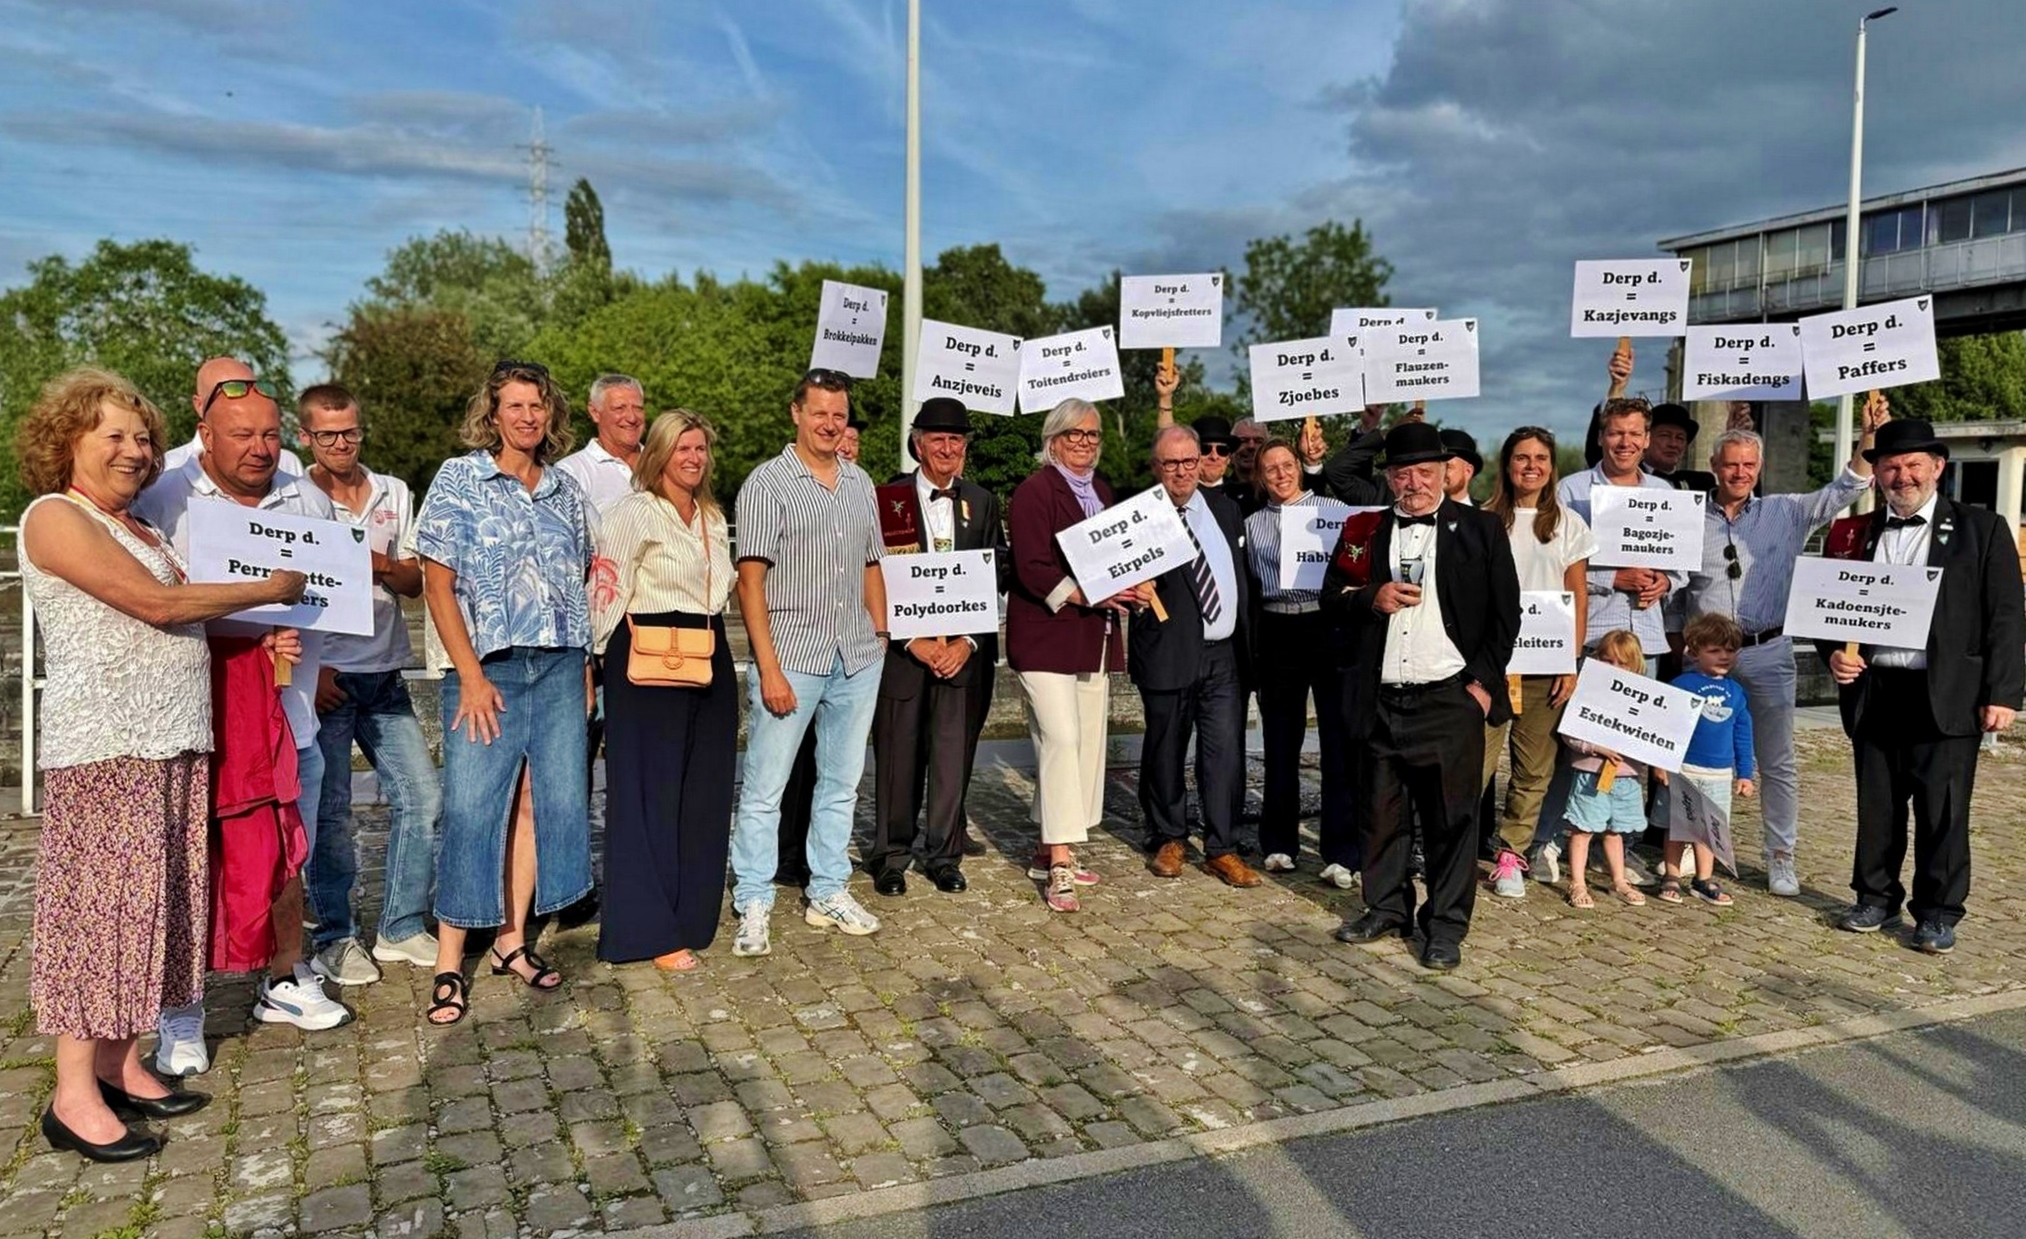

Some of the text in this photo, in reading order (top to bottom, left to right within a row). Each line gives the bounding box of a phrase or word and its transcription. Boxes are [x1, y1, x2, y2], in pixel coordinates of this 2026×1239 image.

[1603, 272, 1662, 286] Derp d.
[1155, 284, 1189, 294] Derp d.
[843, 298, 868, 313] Derp d.
[1132, 308, 1211, 319] Kopvliejsfretters
[1584, 309, 1676, 324] Kazjevangs
[1832, 315, 1902, 338] Derp d.
[824, 328, 877, 346] Brokkelpakken
[1399, 332, 1443, 344] Derp d.
[1715, 336, 1774, 351] Derp d.
[946, 337, 998, 358] Derp d.
[1042, 342, 1086, 358] Derp d.
[1278, 349, 1334, 366] Derp d.
[1396, 362, 1448, 372] Flauzen-
[1838, 360, 1906, 380] Paffers
[1028, 368, 1110, 389] Toitendroiers
[1396, 376, 1449, 386] maukers
[1698, 373, 1790, 388] Fiskadengs
[932, 375, 1001, 398] Anzjeveis
[1279, 388, 1339, 406] Zjoebes
[1628, 499, 1672, 512] Derp d.
[250, 522, 319, 544] Derp d.
[1088, 510, 1147, 544] Derp d.
[1623, 528, 1674, 542] Bagozje-
[1622, 544, 1673, 554] maukers
[1108, 548, 1164, 579] Eirpels
[1296, 551, 1332, 563] Habb
[911, 564, 966, 579] Derp d.
[1839, 572, 1894, 585] Derp d.
[894, 600, 986, 618] Polydoorkes
[1528, 604, 1541, 614] d.
[1816, 598, 1906, 616] Kadoensjte-
[1825, 617, 1890, 629] maukers
[1512, 637, 1564, 648] eleiters
[1610, 680, 1666, 709] Derp d.
[1579, 706, 1674, 750] Estekwieten
